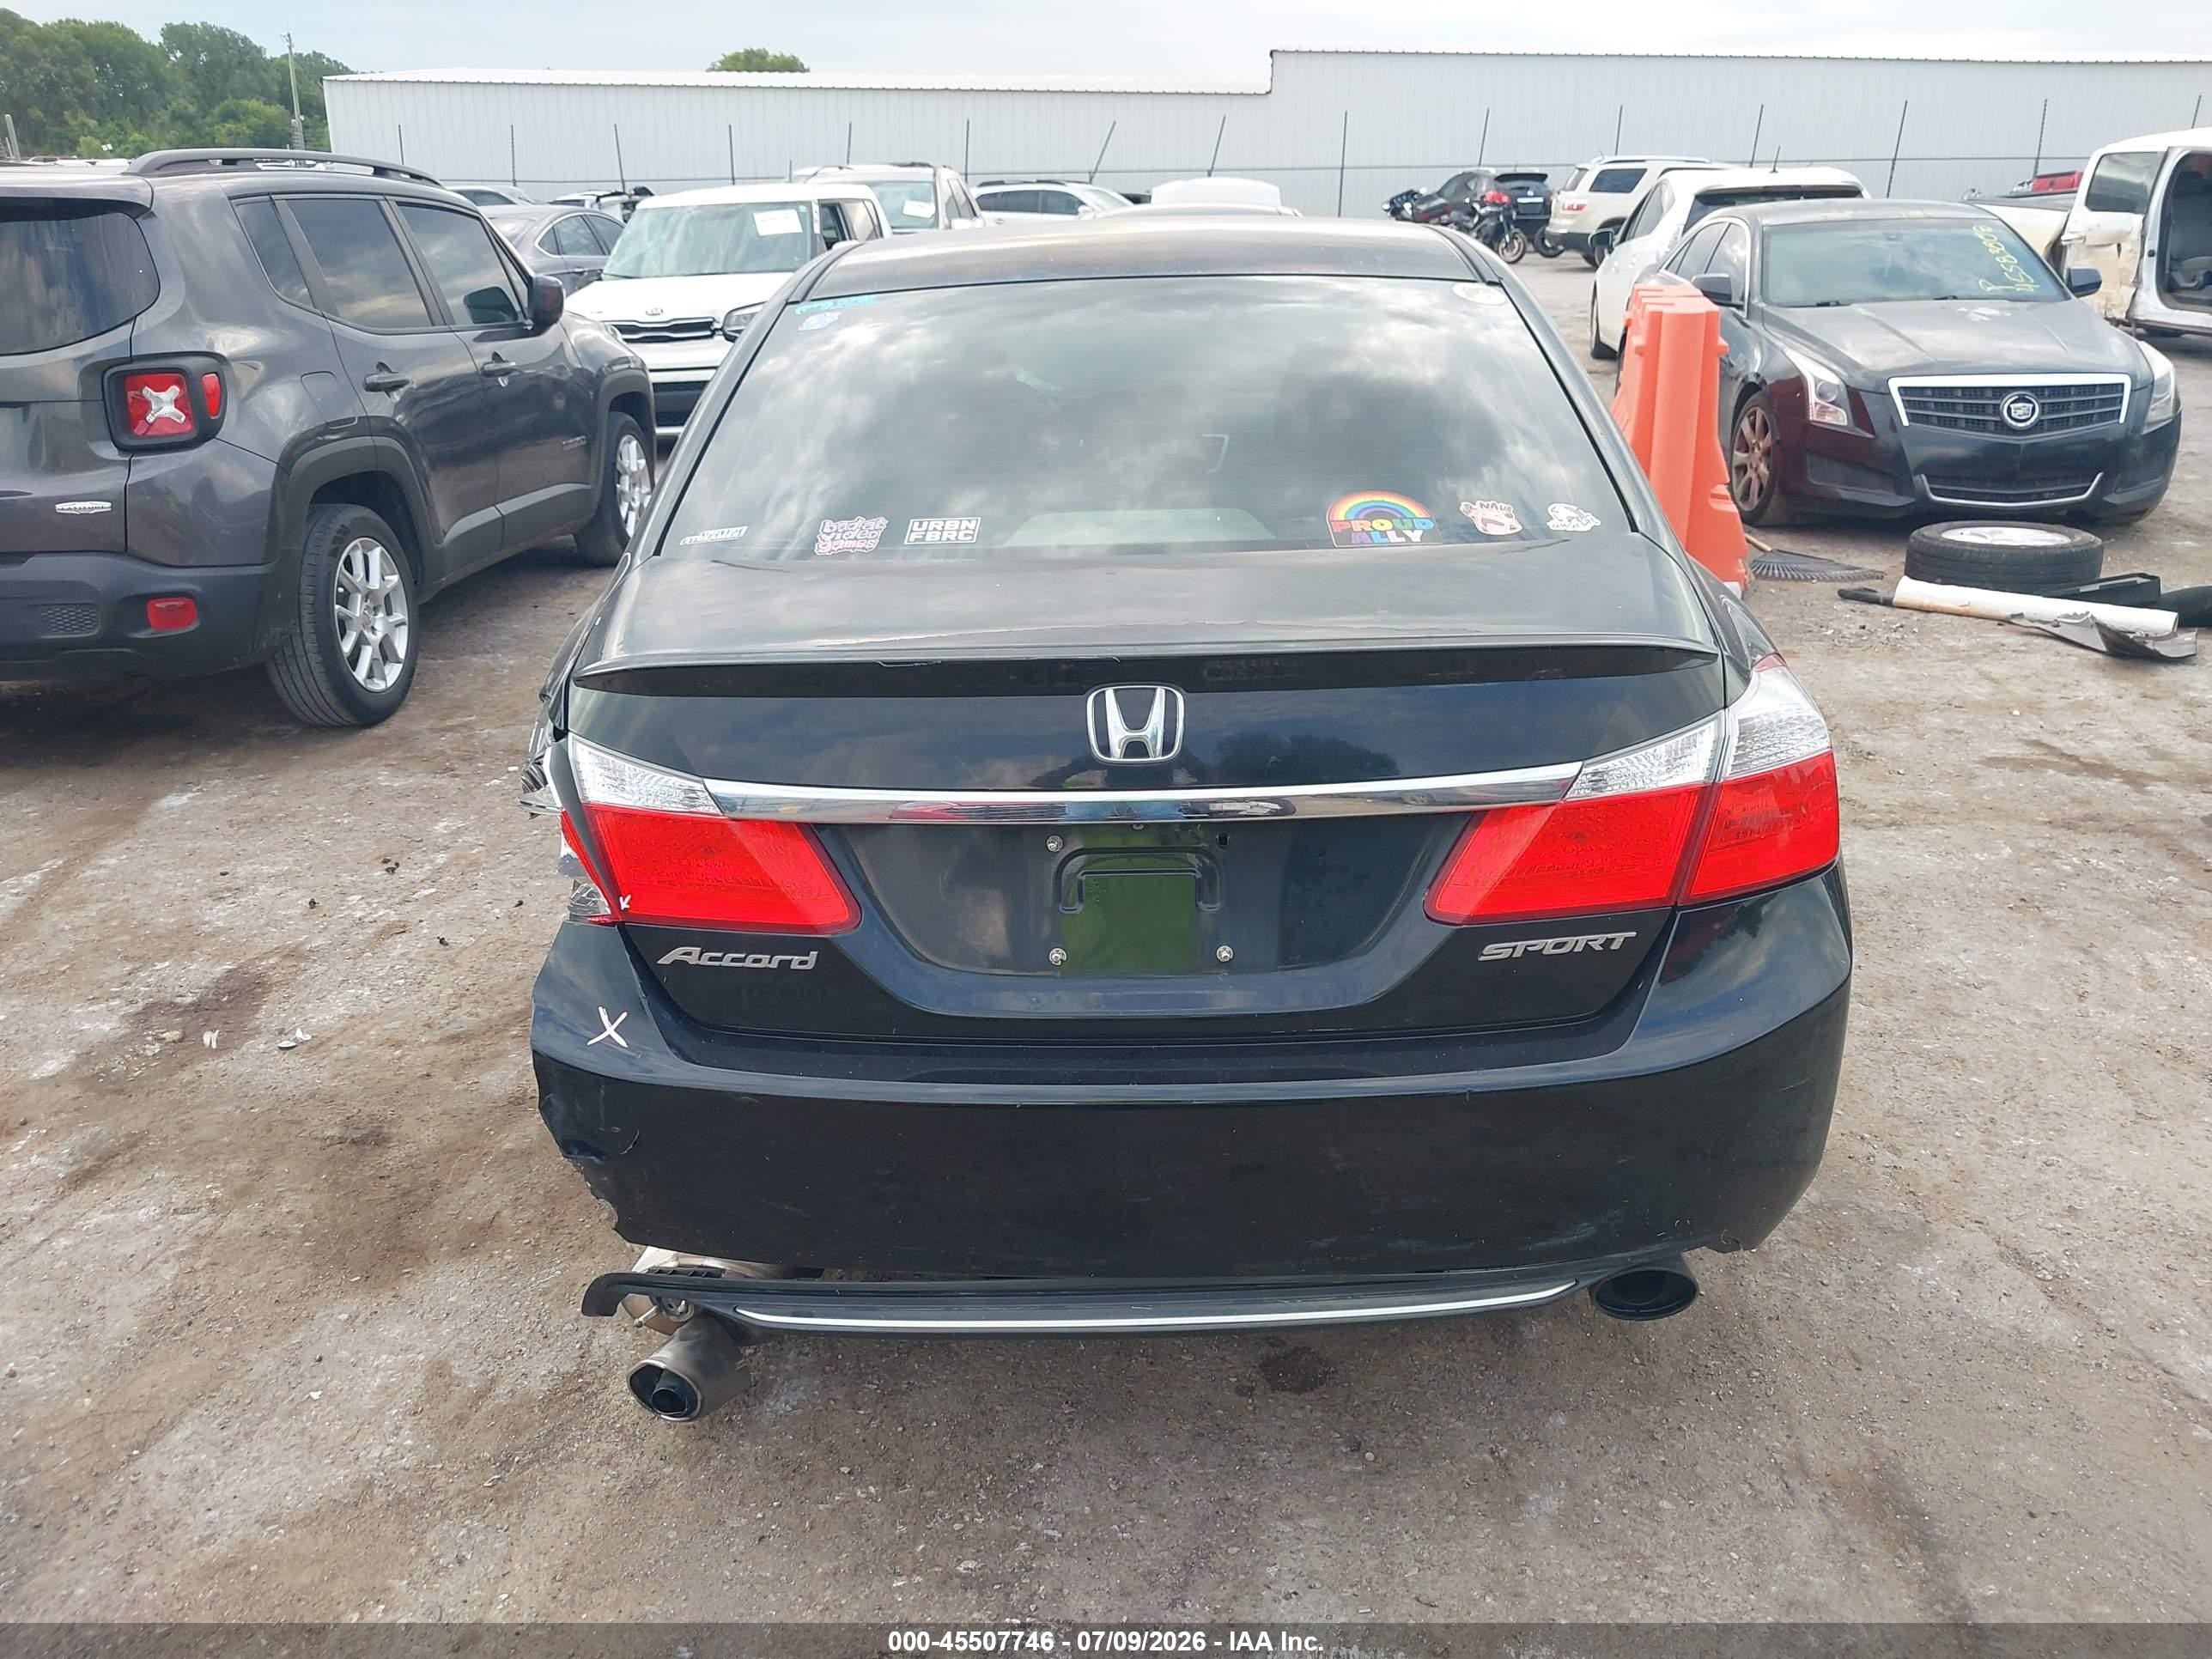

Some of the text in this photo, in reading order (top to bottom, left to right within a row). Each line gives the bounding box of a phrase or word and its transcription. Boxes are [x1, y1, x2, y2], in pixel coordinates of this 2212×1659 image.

[912, 520, 974, 531] URBN
[1330, 519, 1435, 533] PROUD
[909, 532, 972, 542] FBRC
[1351, 530, 1425, 544] ALLY
[817, 538, 878, 552] games
[1477, 931, 1637, 962] SPORT
[657, 946, 818, 970] Accord
